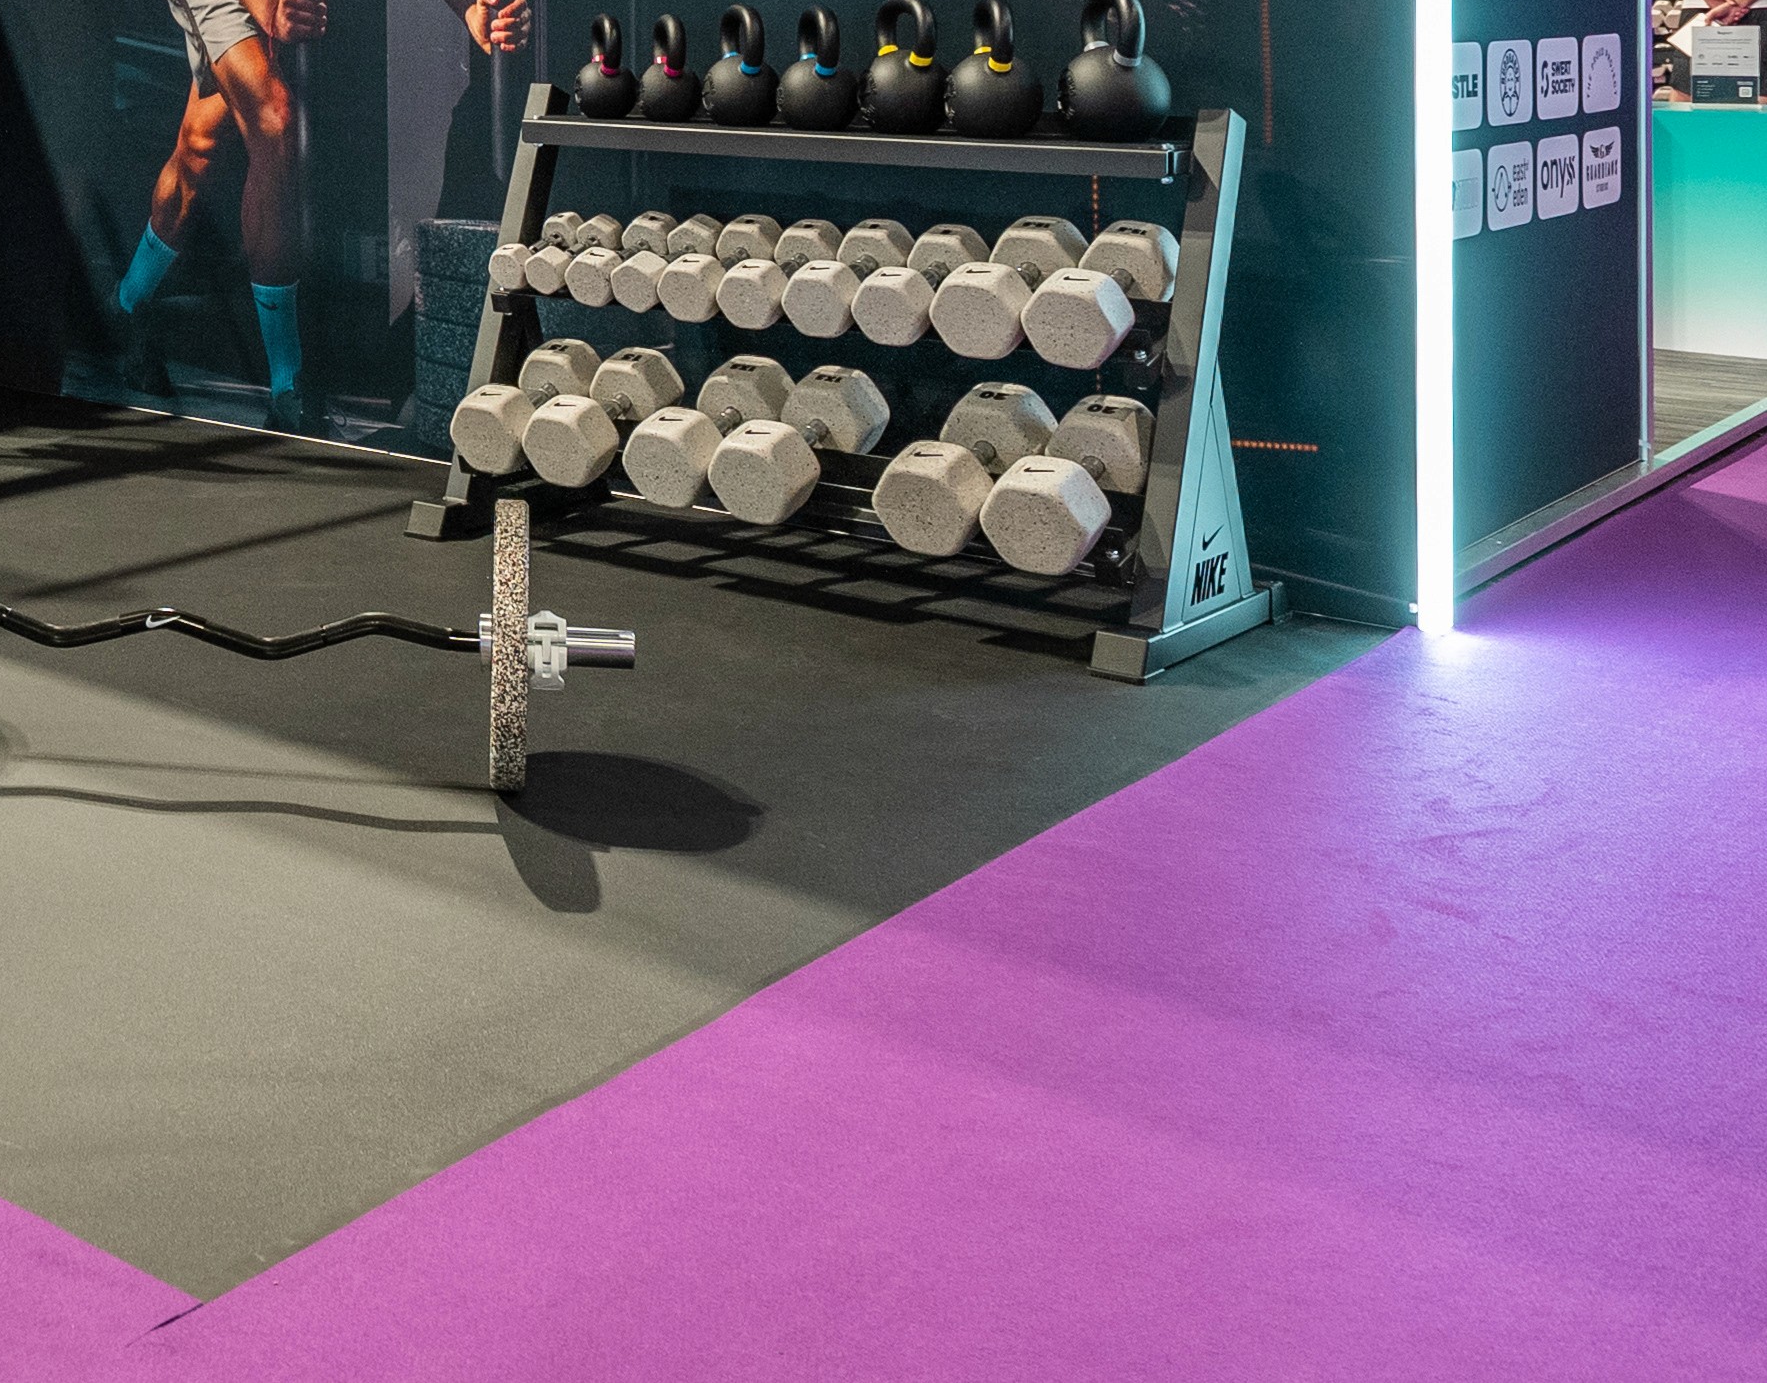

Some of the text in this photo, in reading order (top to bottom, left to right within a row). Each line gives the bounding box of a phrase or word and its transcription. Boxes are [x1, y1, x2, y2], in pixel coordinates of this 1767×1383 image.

[1551, 60, 1572, 77] SWEAT
[1551, 78, 1576, 95] SOCIETY
[979, 390, 1009, 401] 20
[1087, 403, 1119, 414] 20
[1190, 551, 1229, 607] NIKE
